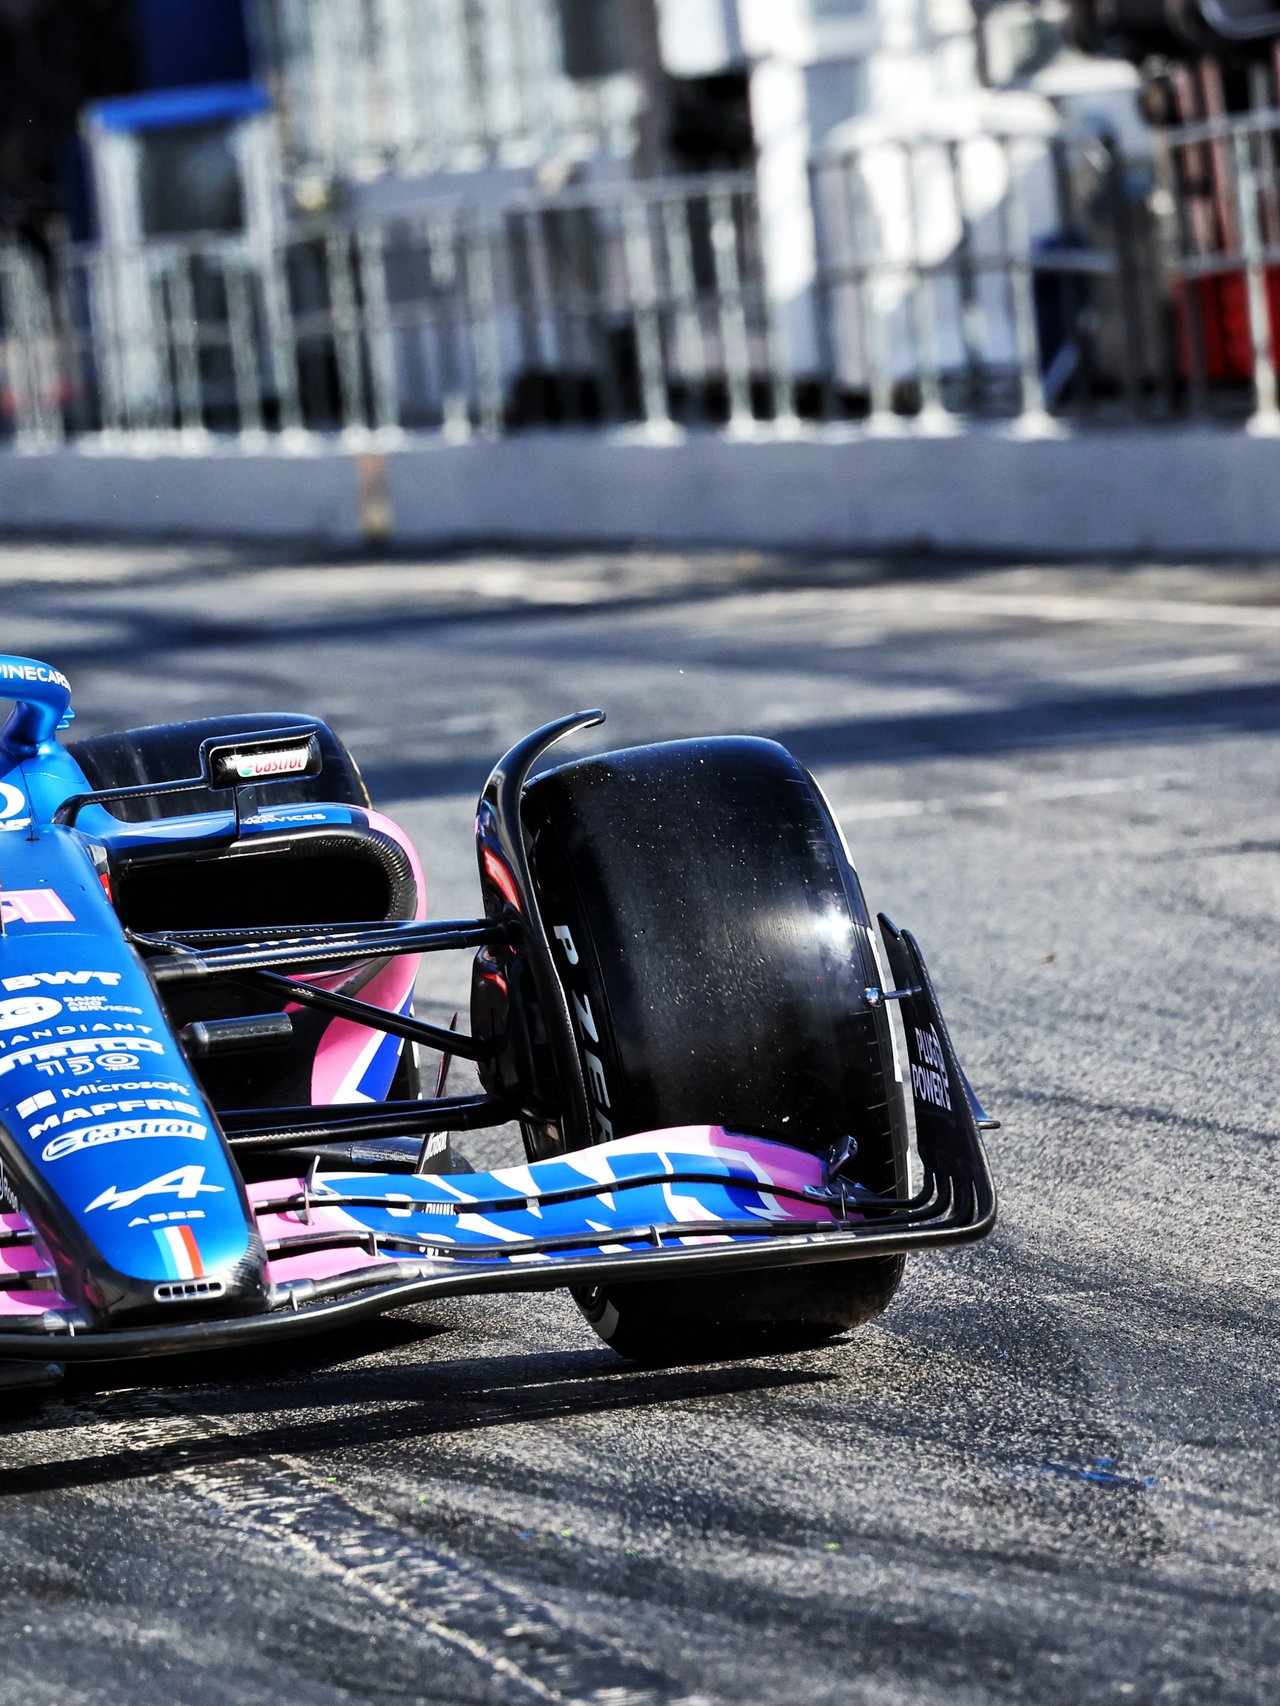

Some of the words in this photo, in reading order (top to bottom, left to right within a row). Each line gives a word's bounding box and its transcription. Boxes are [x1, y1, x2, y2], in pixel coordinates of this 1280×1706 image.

[1, 970, 122, 992] BWT
[61, 1080, 191, 1099] Microsoft
[28, 1098, 202, 1140] MAPFRE
[81, 1121, 195, 1144] Castrol
[127, 1209, 207, 1228] A522
